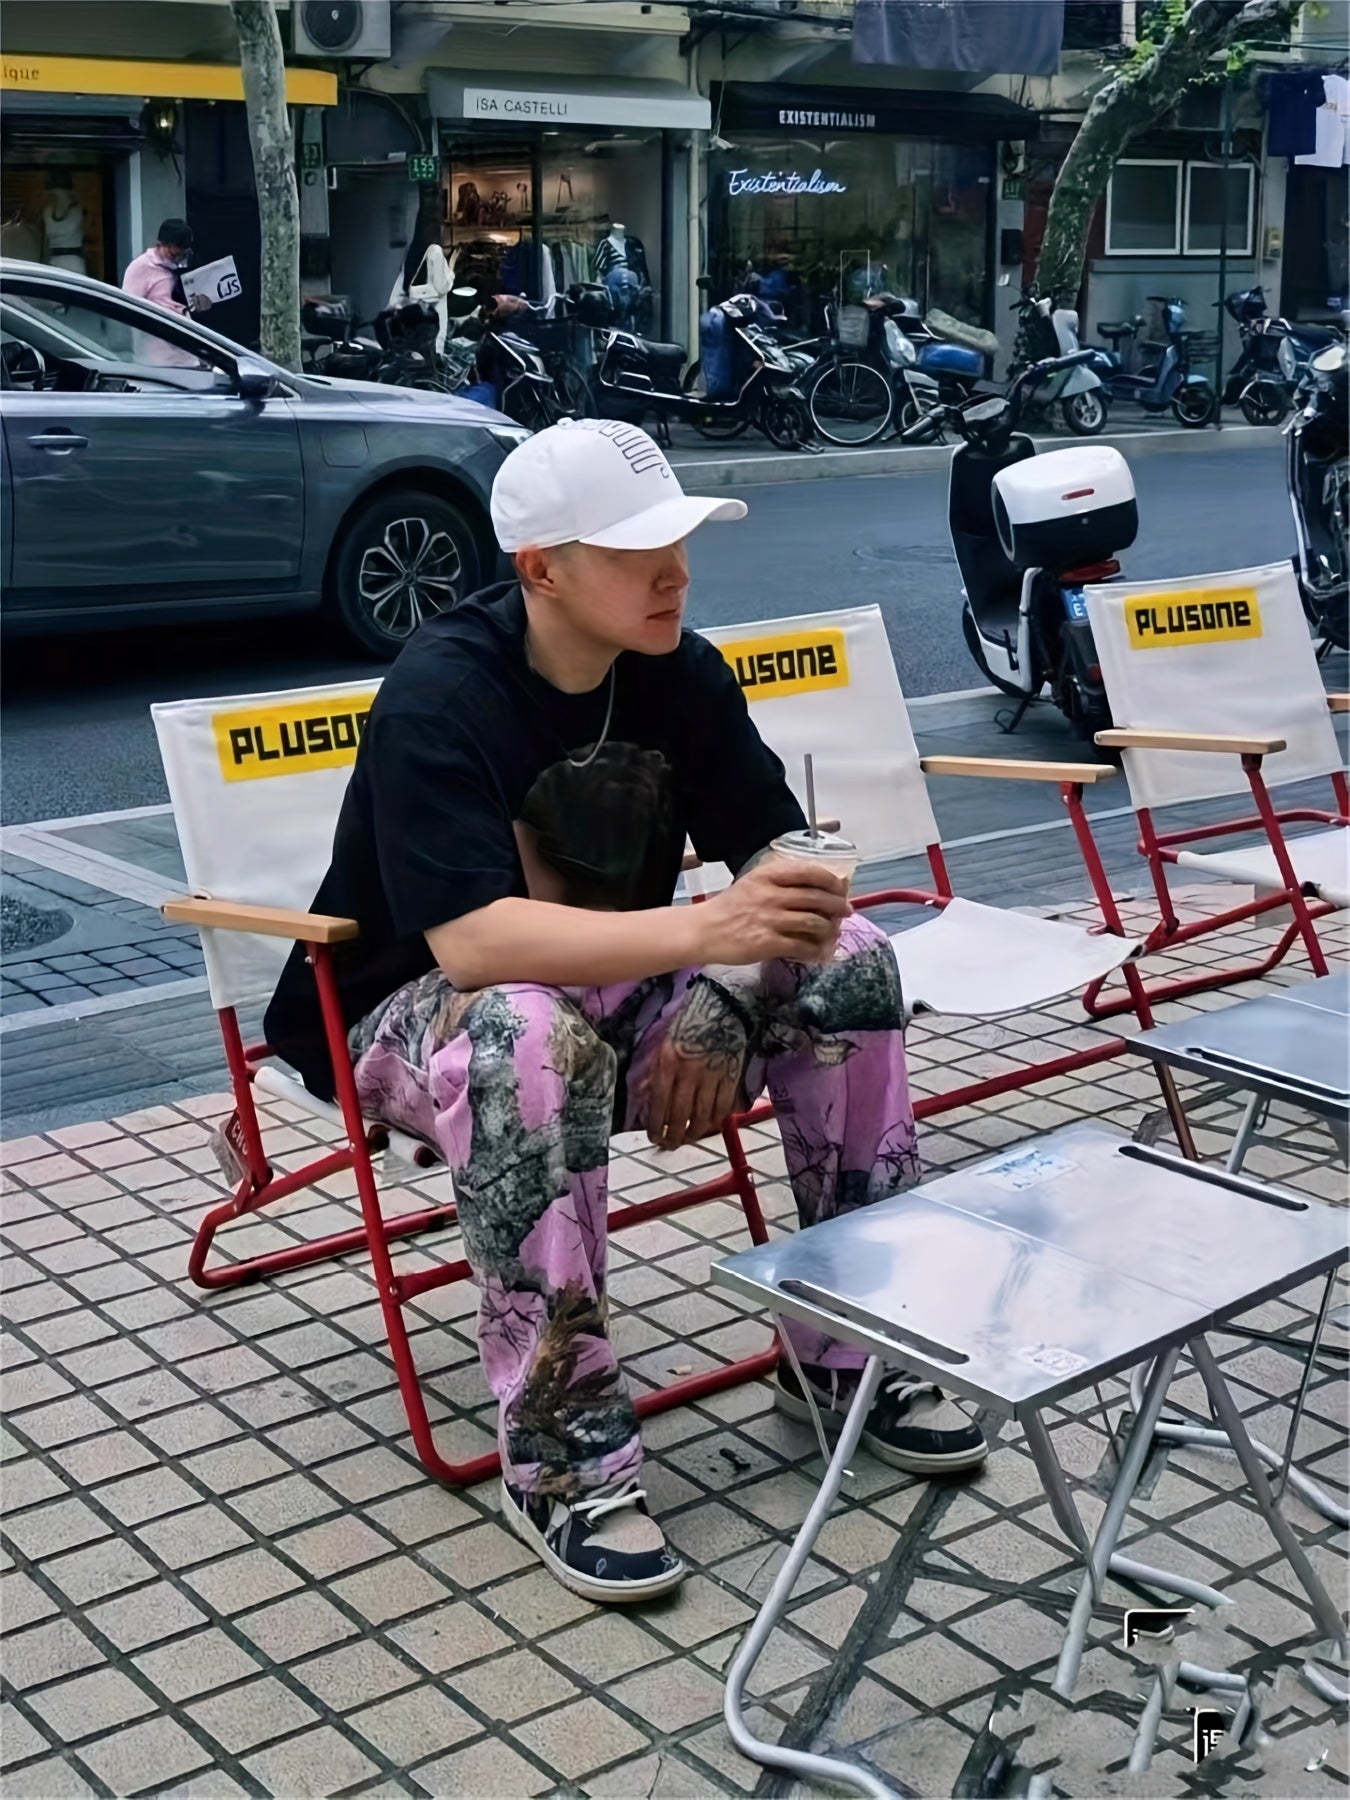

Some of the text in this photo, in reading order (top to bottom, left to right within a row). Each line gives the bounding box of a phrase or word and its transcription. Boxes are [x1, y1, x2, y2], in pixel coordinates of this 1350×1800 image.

[476, 97, 567, 116] ISA CASTELLI
[779, 109, 875, 127] EXISTENTIALISM
